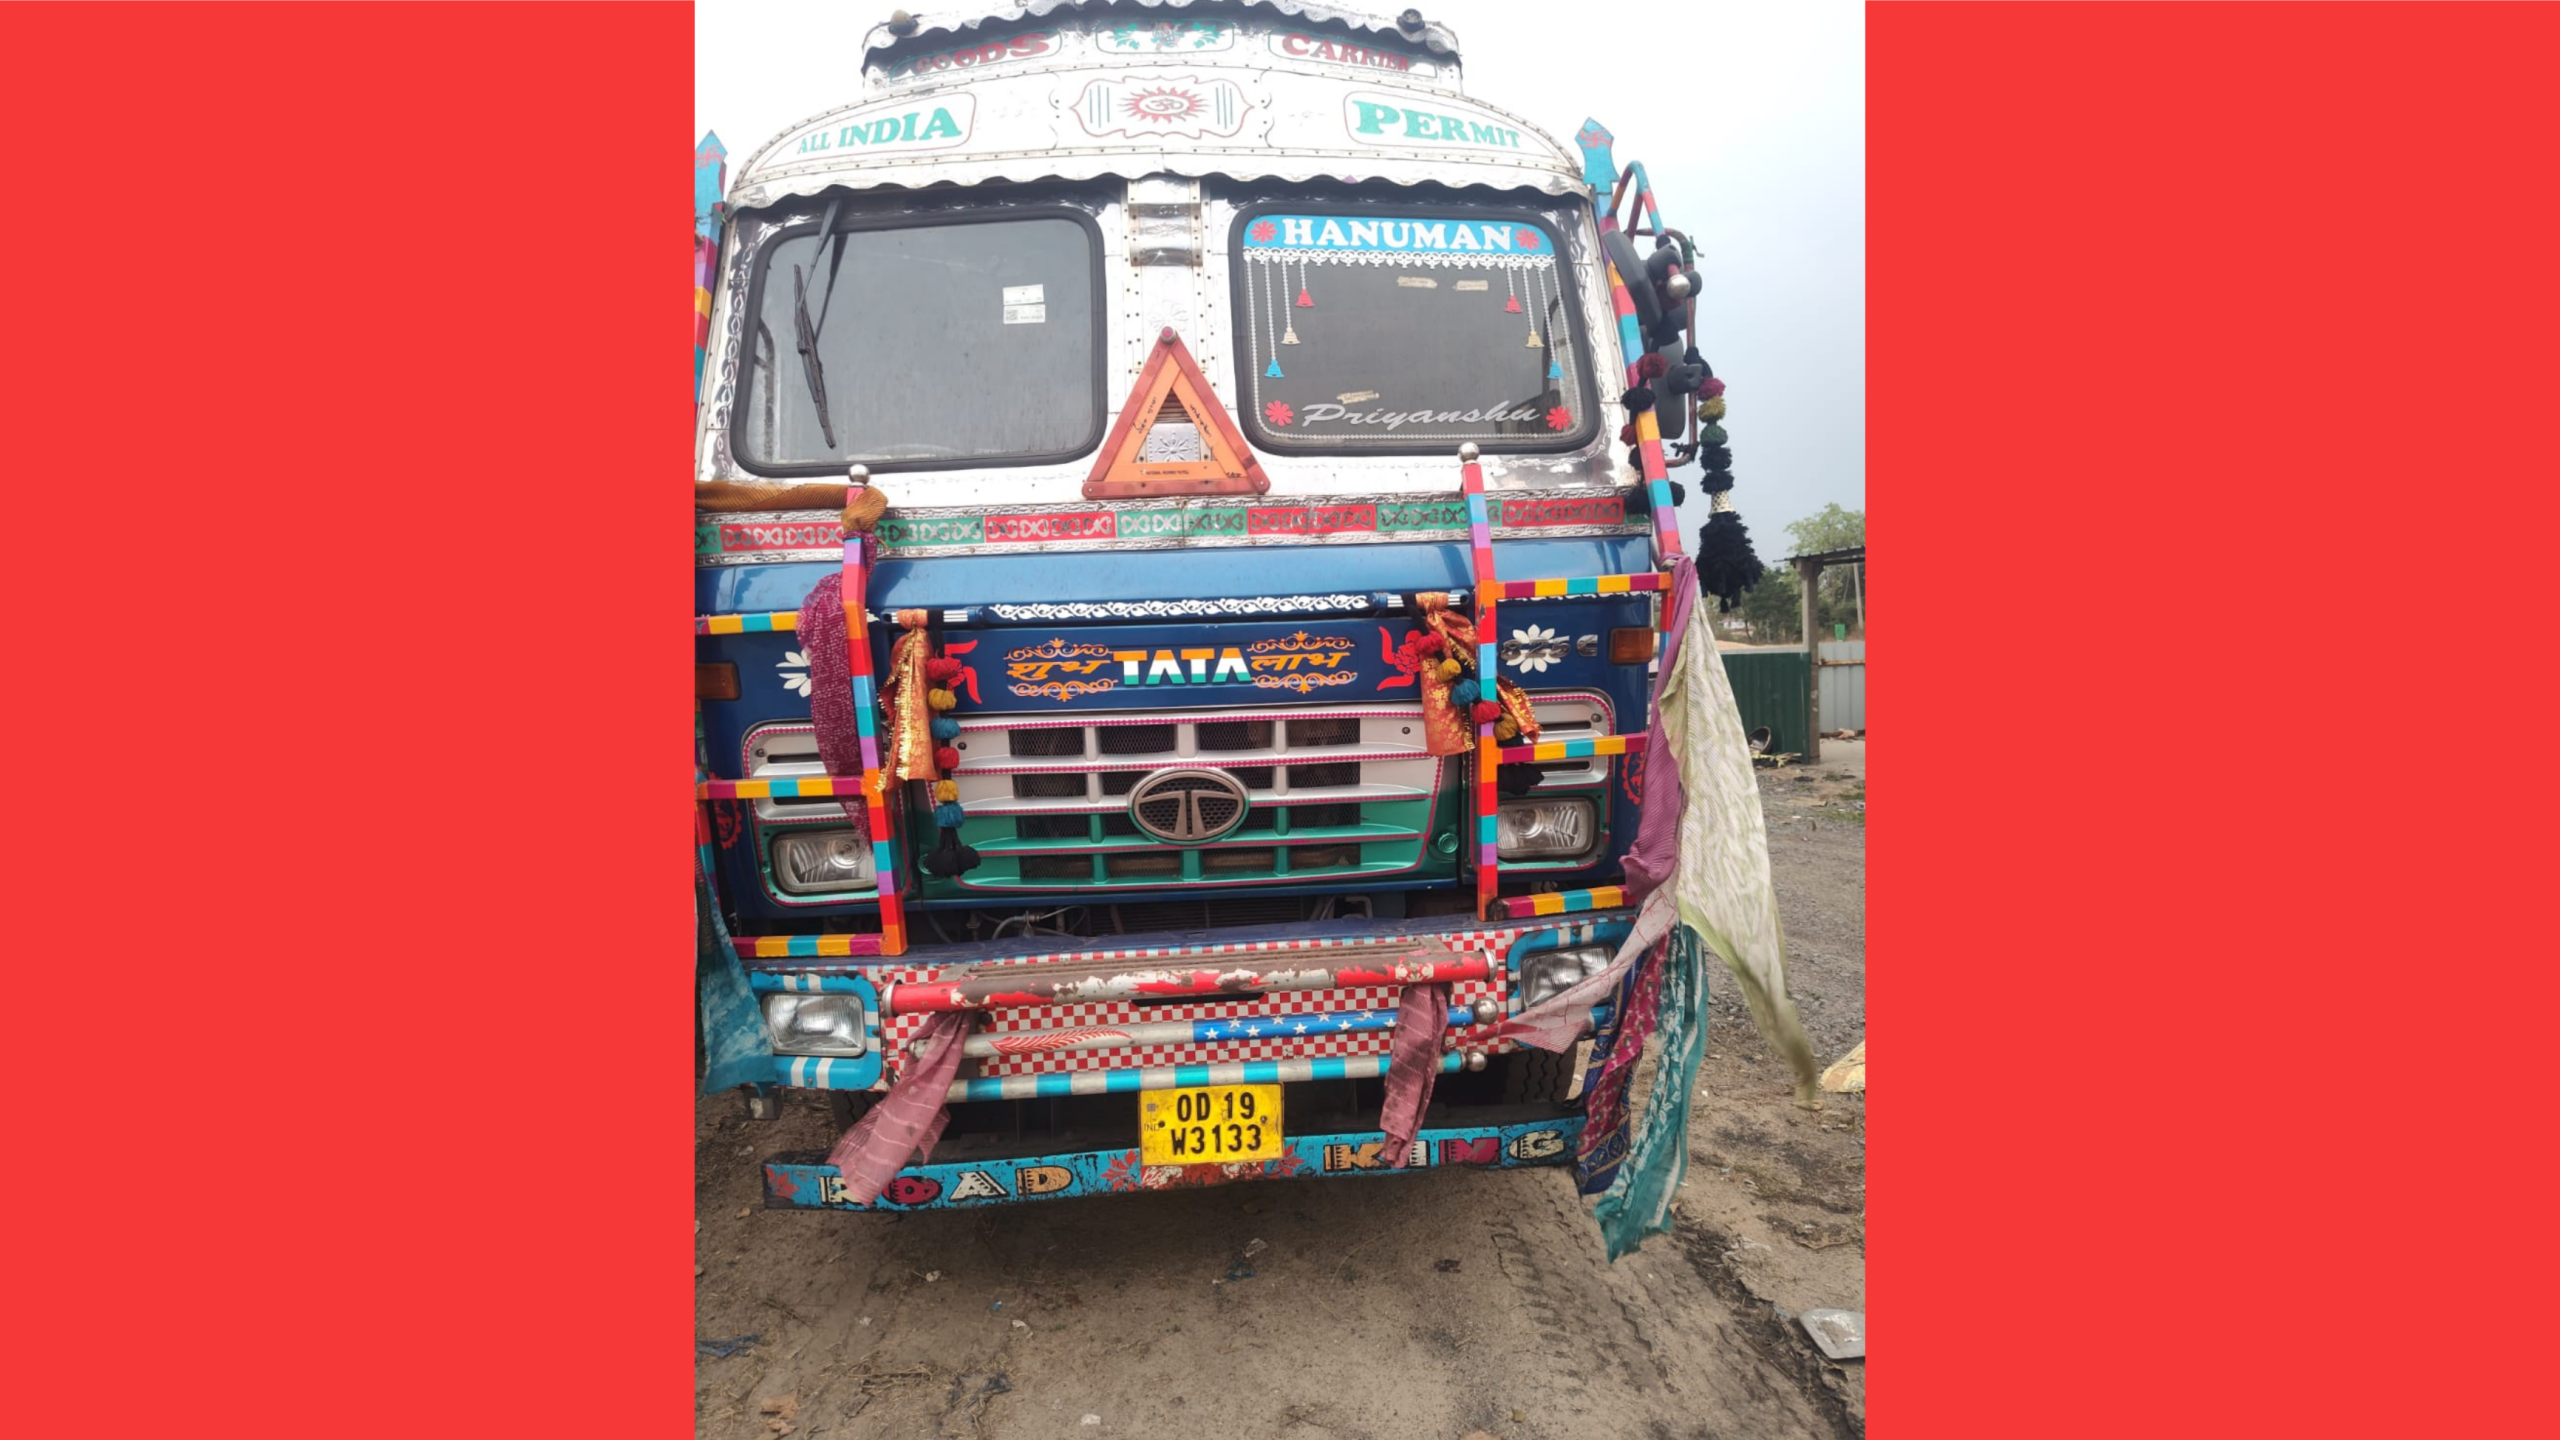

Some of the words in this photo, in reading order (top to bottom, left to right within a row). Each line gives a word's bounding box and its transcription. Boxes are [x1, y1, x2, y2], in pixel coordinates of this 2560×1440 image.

[916, 33, 1050, 73] GOODS
[1282, 33, 1410, 72] CARRIER
[796, 132, 832, 154] ALL
[838, 107, 963, 148] INDIA
[1352, 100, 1521, 148] PERMIT
[1281, 218, 1512, 251] HANUMAN
[1301, 400, 1541, 431] Priyanshu
[1006, 659, 1111, 682] शुभ
[1113, 647, 1253, 686] TATA
[1250, 651, 1351, 671] लाभ
[1176, 1092, 1211, 1122] OD
[1224, 1091, 1256, 1120] 19
[1170, 1123, 1262, 1156] W3133
